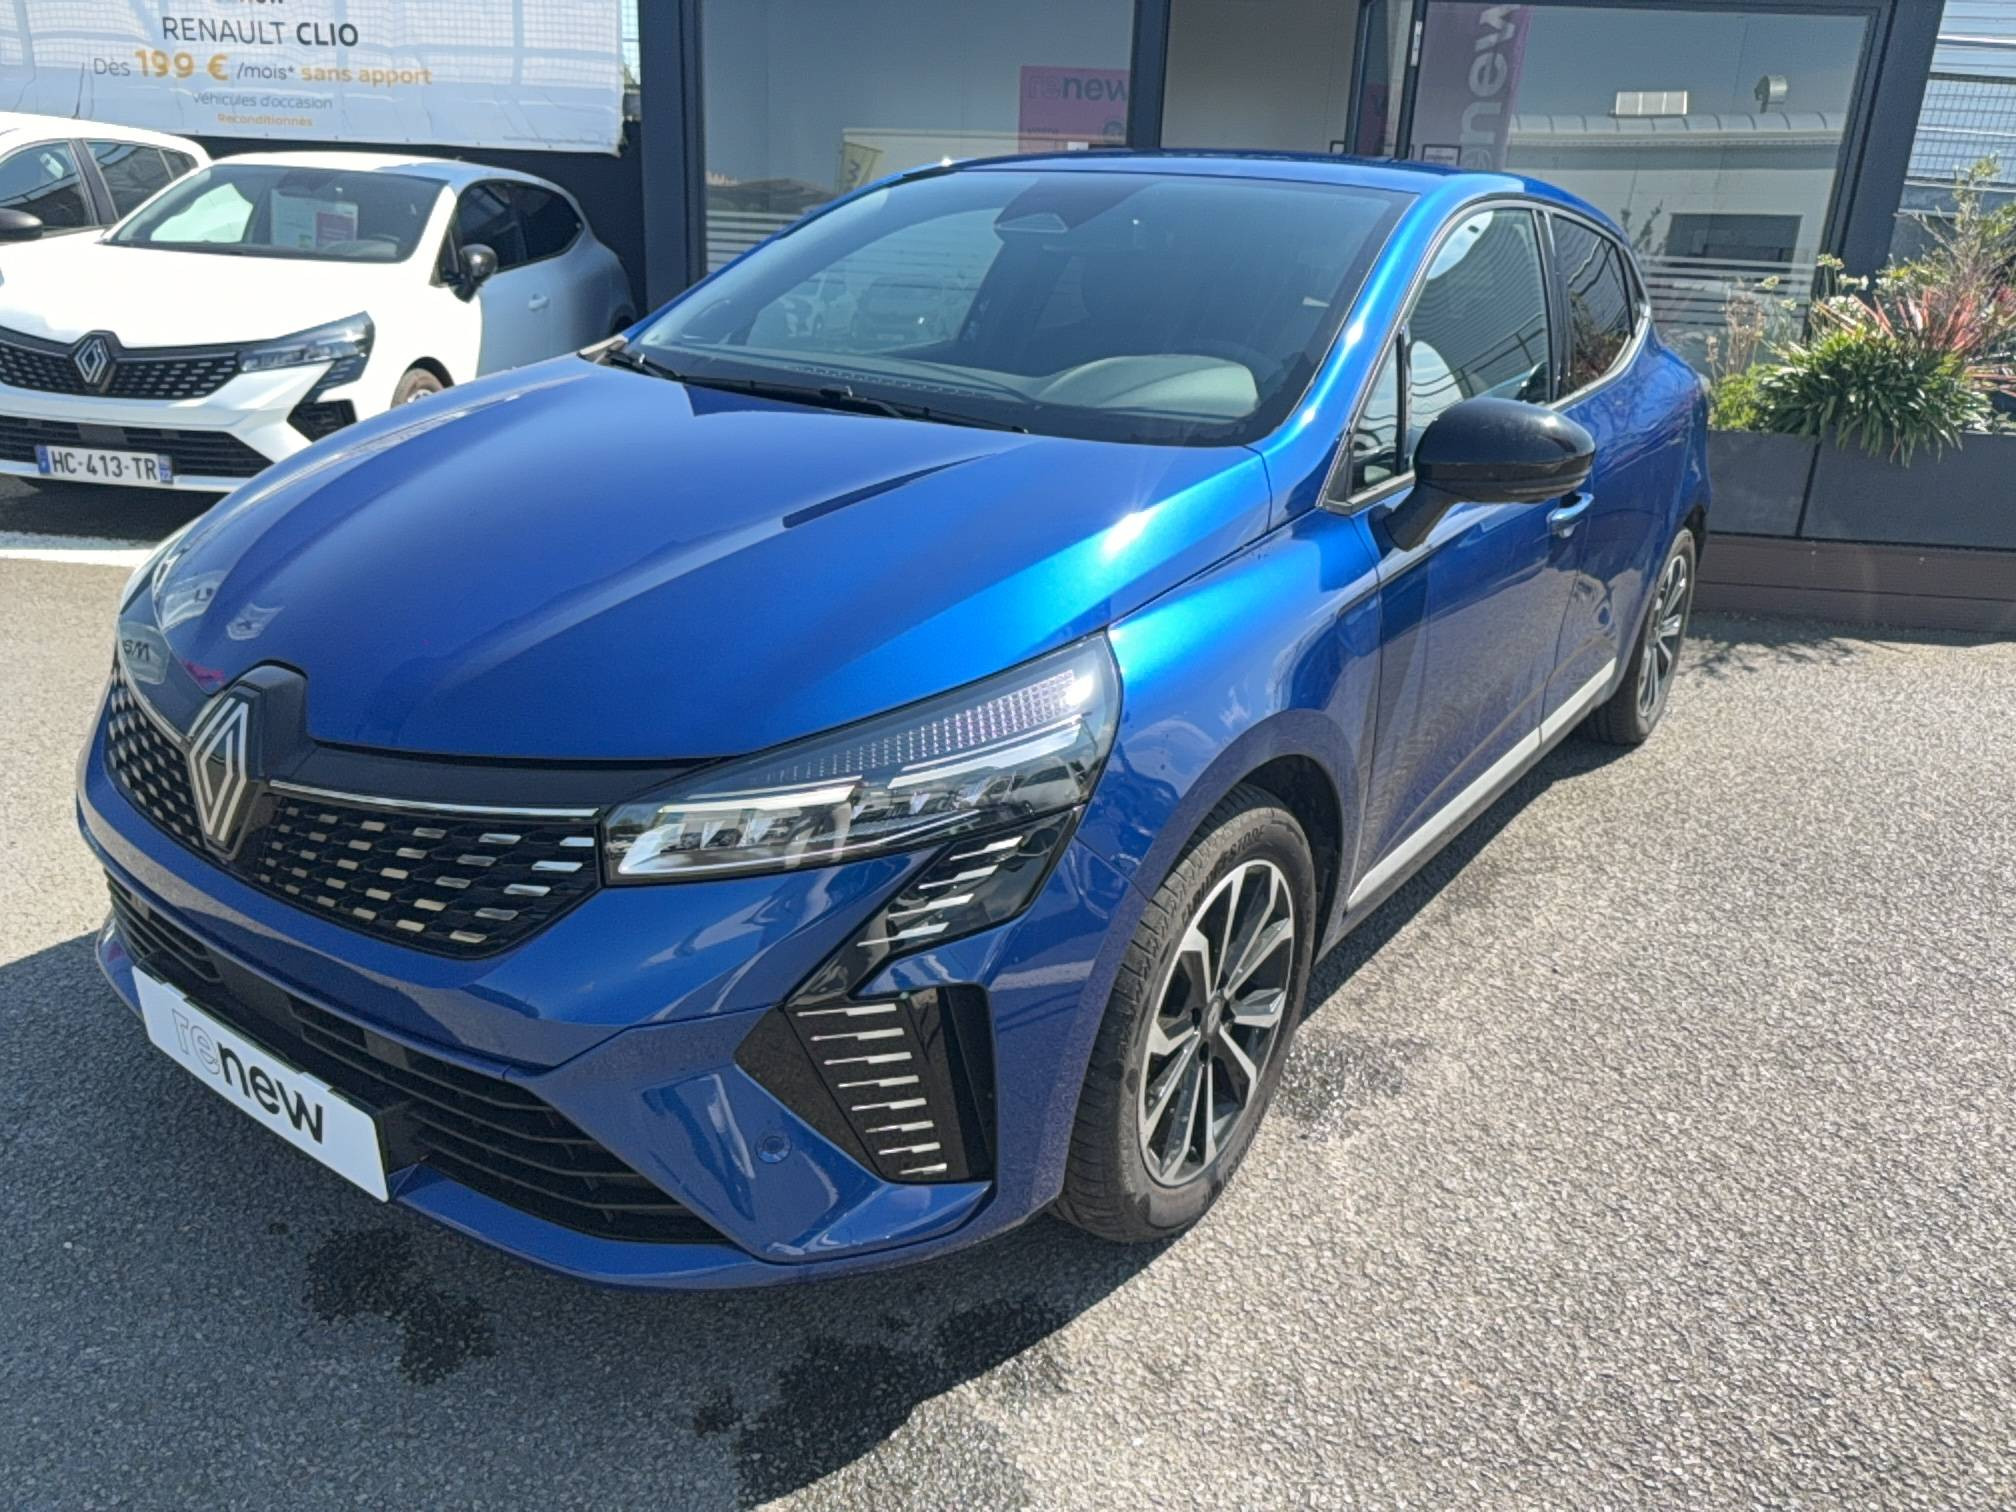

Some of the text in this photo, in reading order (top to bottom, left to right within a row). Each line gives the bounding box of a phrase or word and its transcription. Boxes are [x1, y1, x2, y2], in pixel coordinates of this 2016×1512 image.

[162, 16, 359, 47] RENAULT CLIO
[93, 57, 131, 77] Dès
[134, 49, 195, 79] 199
[207, 54, 229, 81] €
[301, 66, 352, 82] sans
[358, 67, 432, 89] apport
[51, 450, 158, 481] HC-413-TR
[171, 1007, 323, 1145] renew
